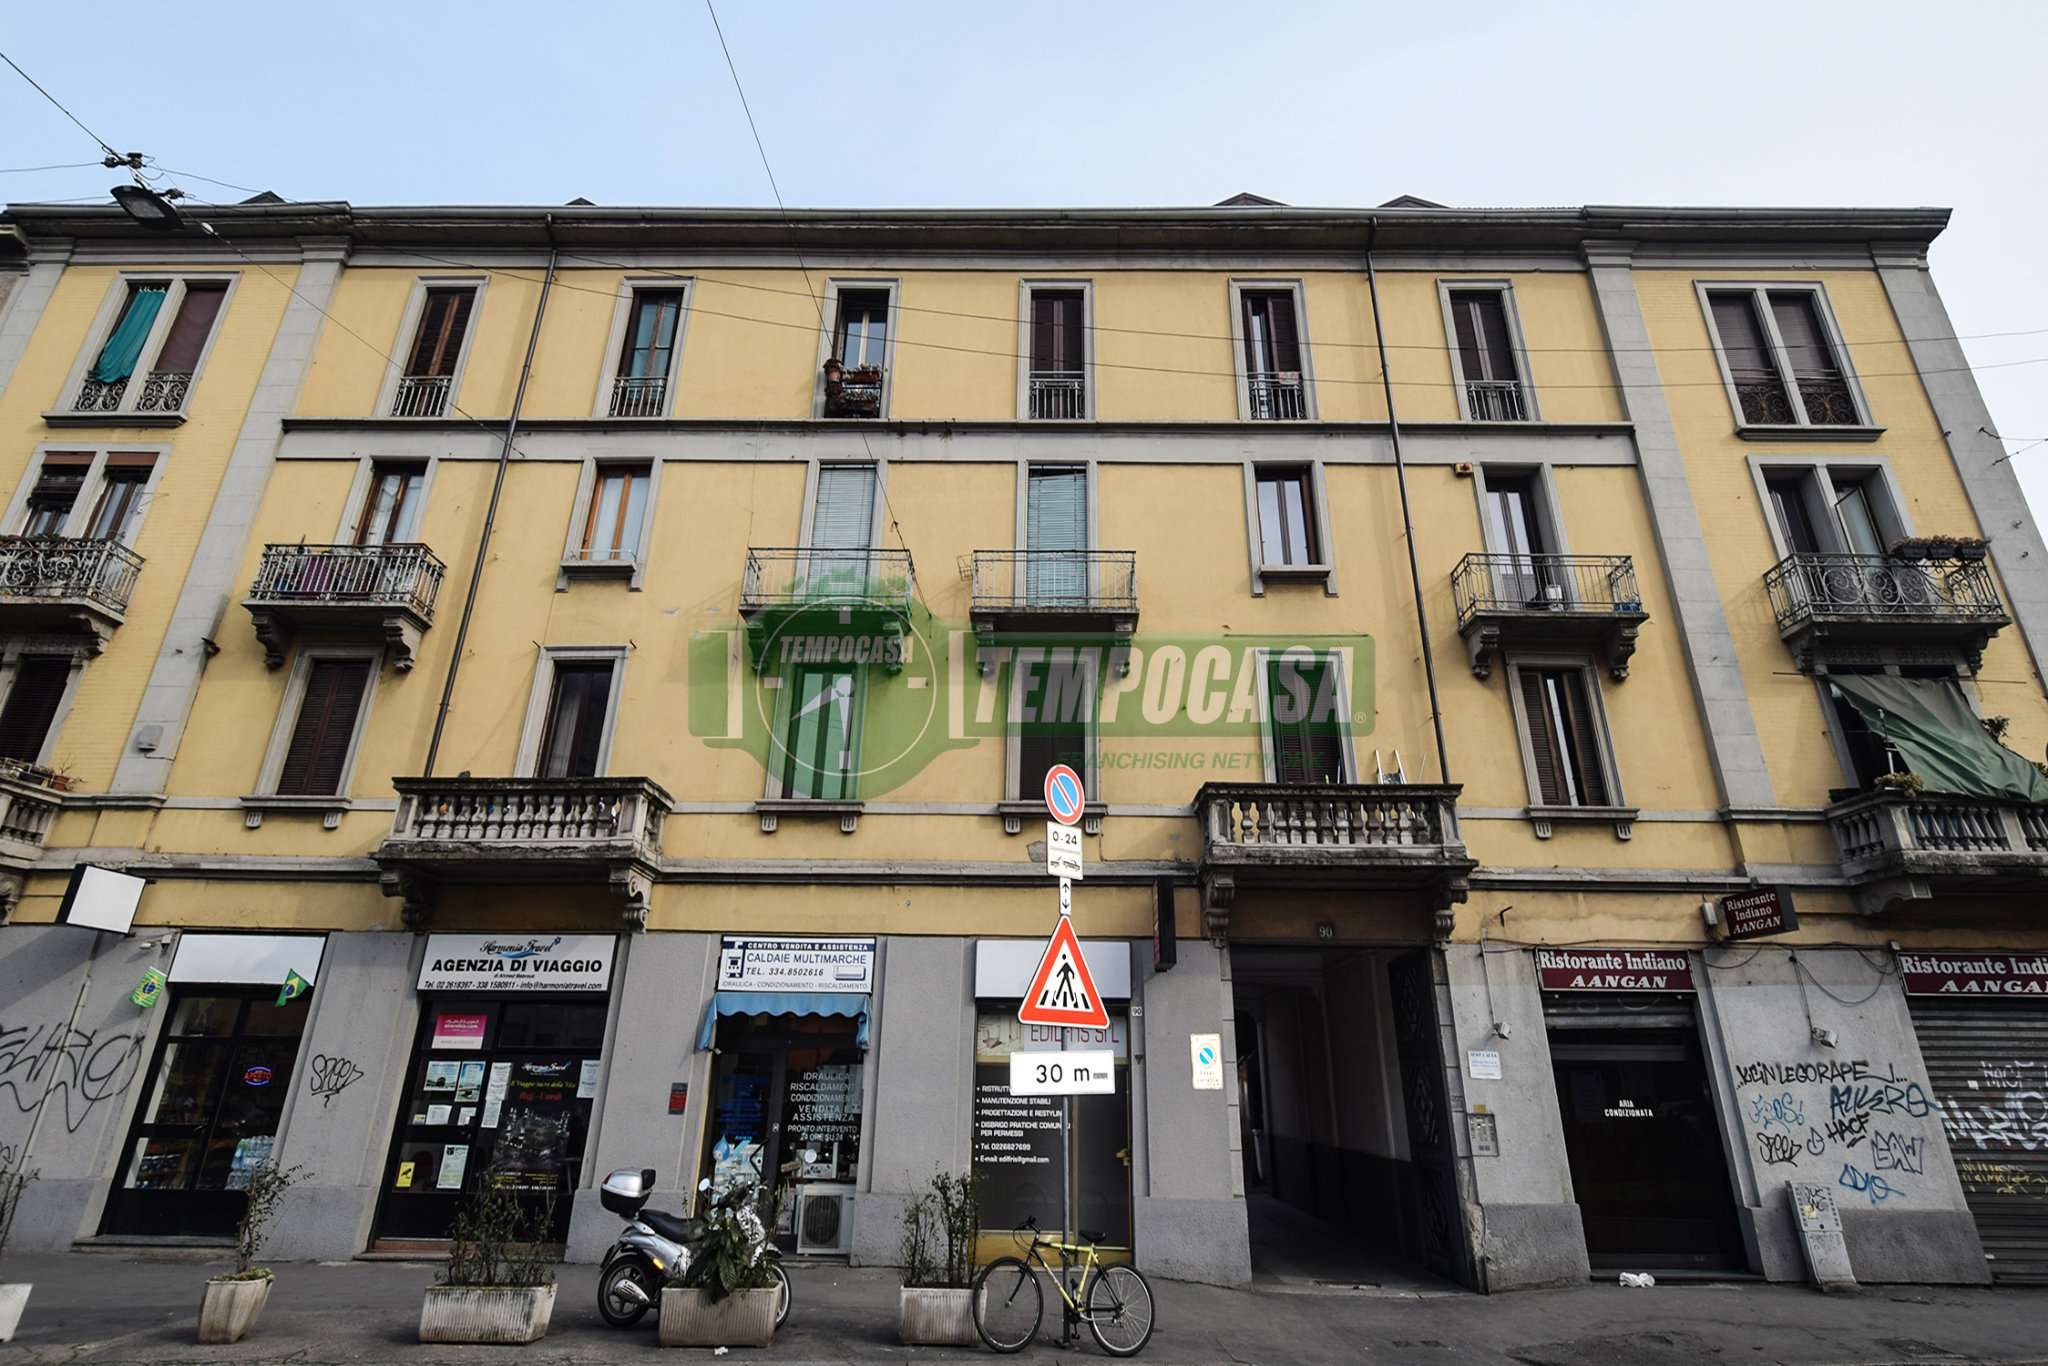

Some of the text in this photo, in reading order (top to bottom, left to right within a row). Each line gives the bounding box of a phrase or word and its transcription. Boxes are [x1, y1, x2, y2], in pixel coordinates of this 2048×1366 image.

[1052, 830, 1060, 842] 0
[1065, 833, 1078, 845] 24
[1726, 892, 1776, 911] Ristorante
[1735, 905, 1773, 921] Indiano
[1733, 916, 1783, 935] AANGAN
[479, 939, 524, 955] Harmonia
[747, 953, 866, 964] CALDAIE MULTIMARCHE
[1540, 952, 1686, 971] Ristorante Indiano
[431, 959, 602, 972] AGENZIA DI VIAGGIO
[746, 967, 824, 976] TEL. 334.8502616
[1900, 956, 2048, 975] Ristorante Indi
[1570, 975, 1668, 988] AANGAN
[803, 1072, 850, 1080] IDRAULICA
[1036, 1064, 1063, 1083] 30
[1074, 1067, 1090, 1082] m
[790, 1083, 860, 1091] RISCALDAMEN
[799, 1105, 840, 1113] VENDITA
[1619, 1100, 1634, 1108] ARIA
[793, 1113, 854, 1121] ASSISTENZA
[1604, 1109, 1654, 1117] CONDIZIONATA
[816, 1125, 857, 1133] INTERVENTO
[809, 1133, 824, 1141] ORE
